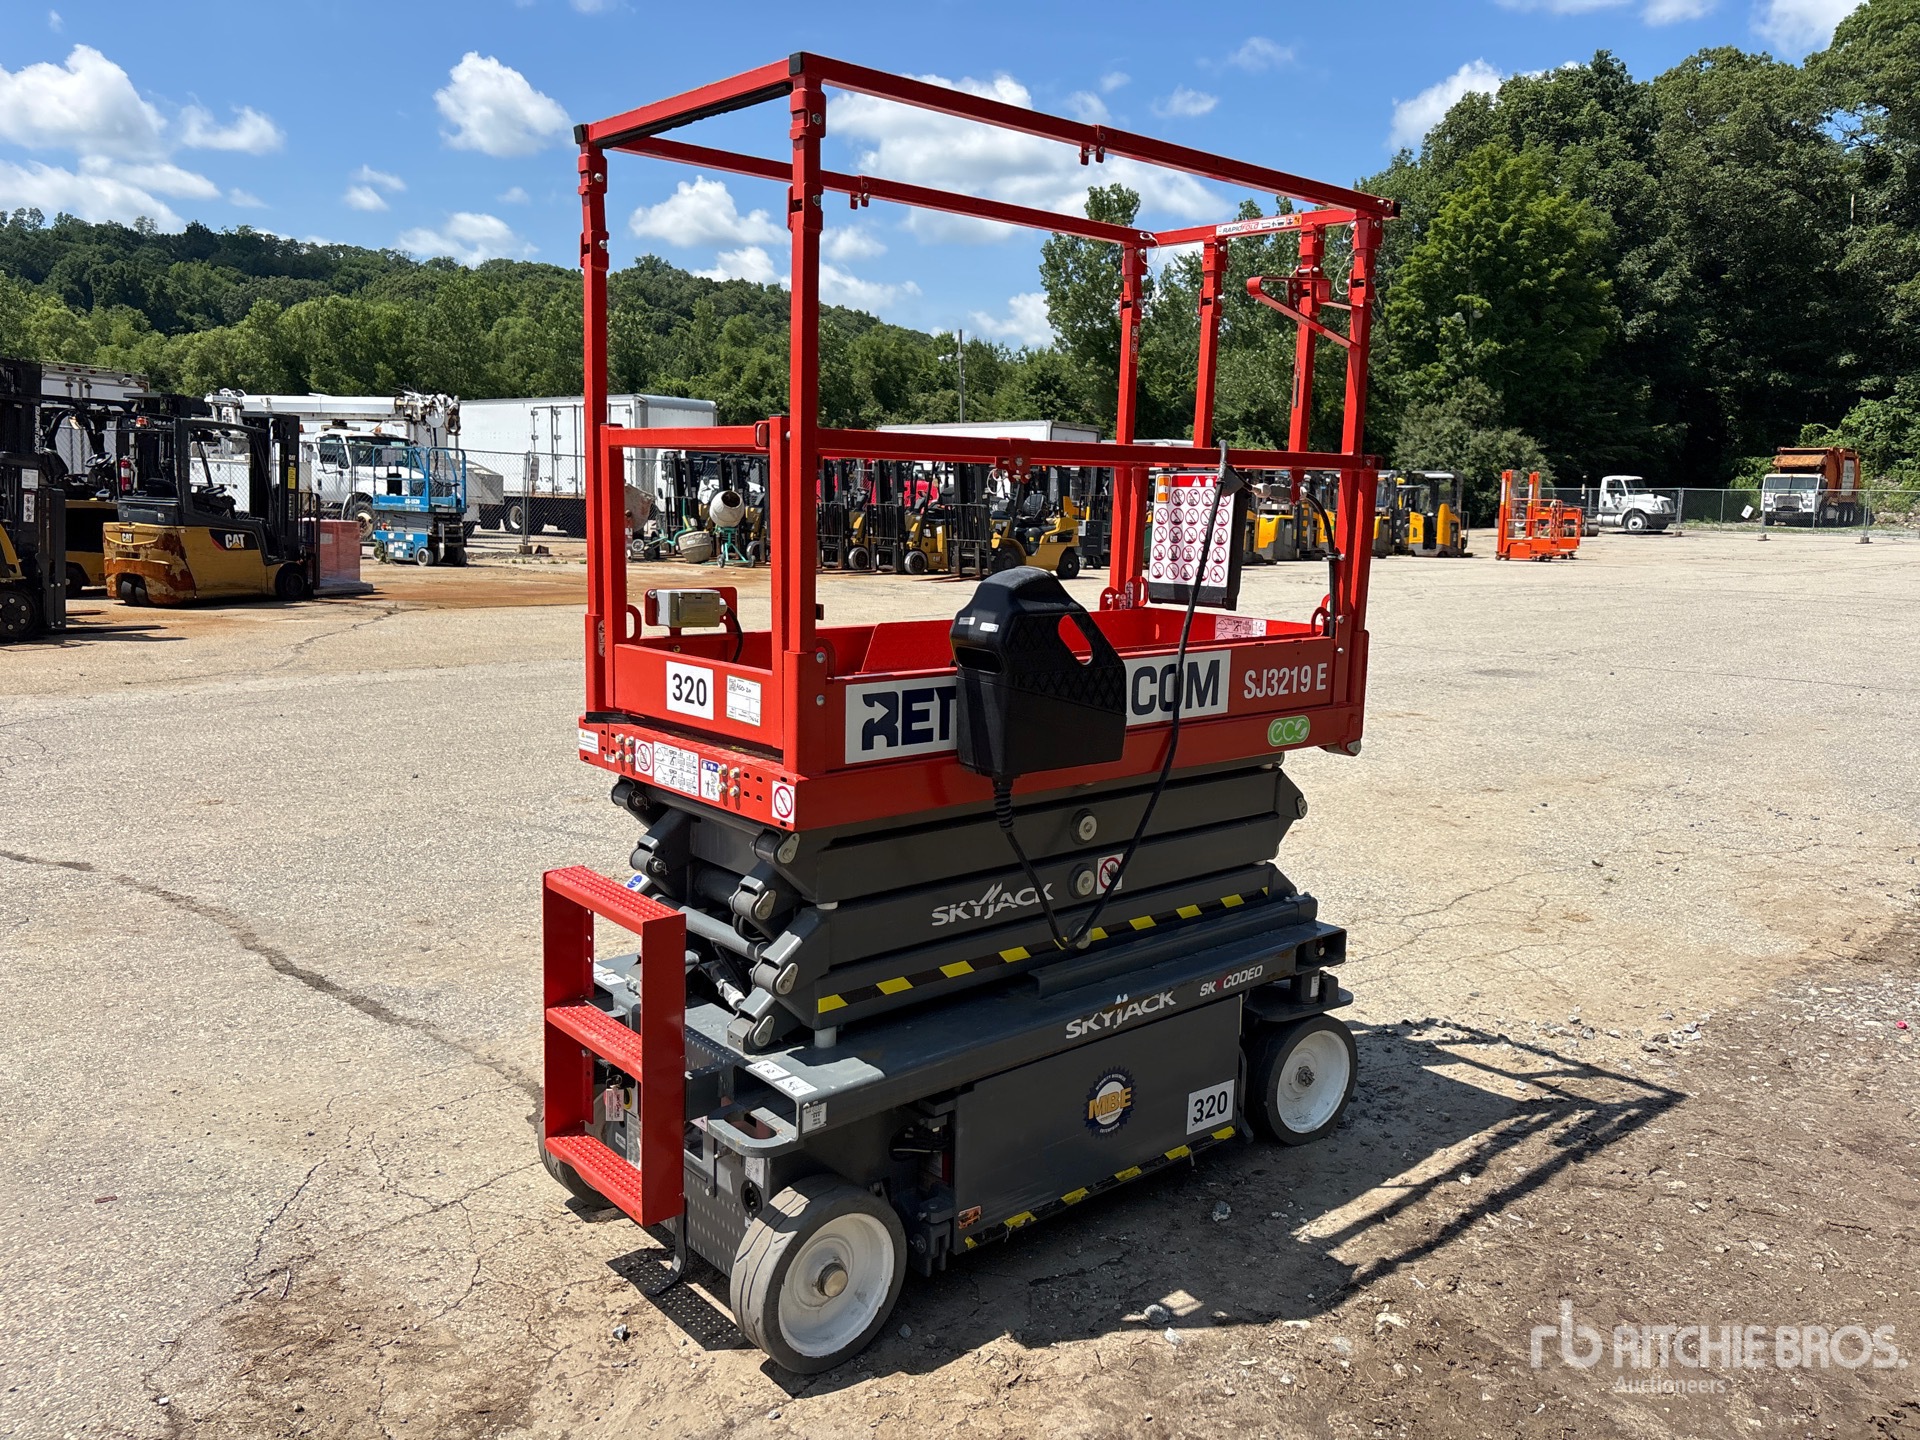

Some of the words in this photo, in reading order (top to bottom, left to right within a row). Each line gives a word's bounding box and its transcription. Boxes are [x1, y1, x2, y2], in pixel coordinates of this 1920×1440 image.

[121, 533, 133, 543] CAT
[224, 534, 245, 549] CAT
[672, 672, 707, 707] 320
[1243, 664, 1312, 700] SJ3219
[1315, 662, 1328, 691] E
[931, 882, 1055, 927] SKYJACK
[1065, 990, 1177, 1040] SKYJACK
[1088, 1087, 1132, 1120] MBE
[1192, 1090, 1228, 1123] 320
